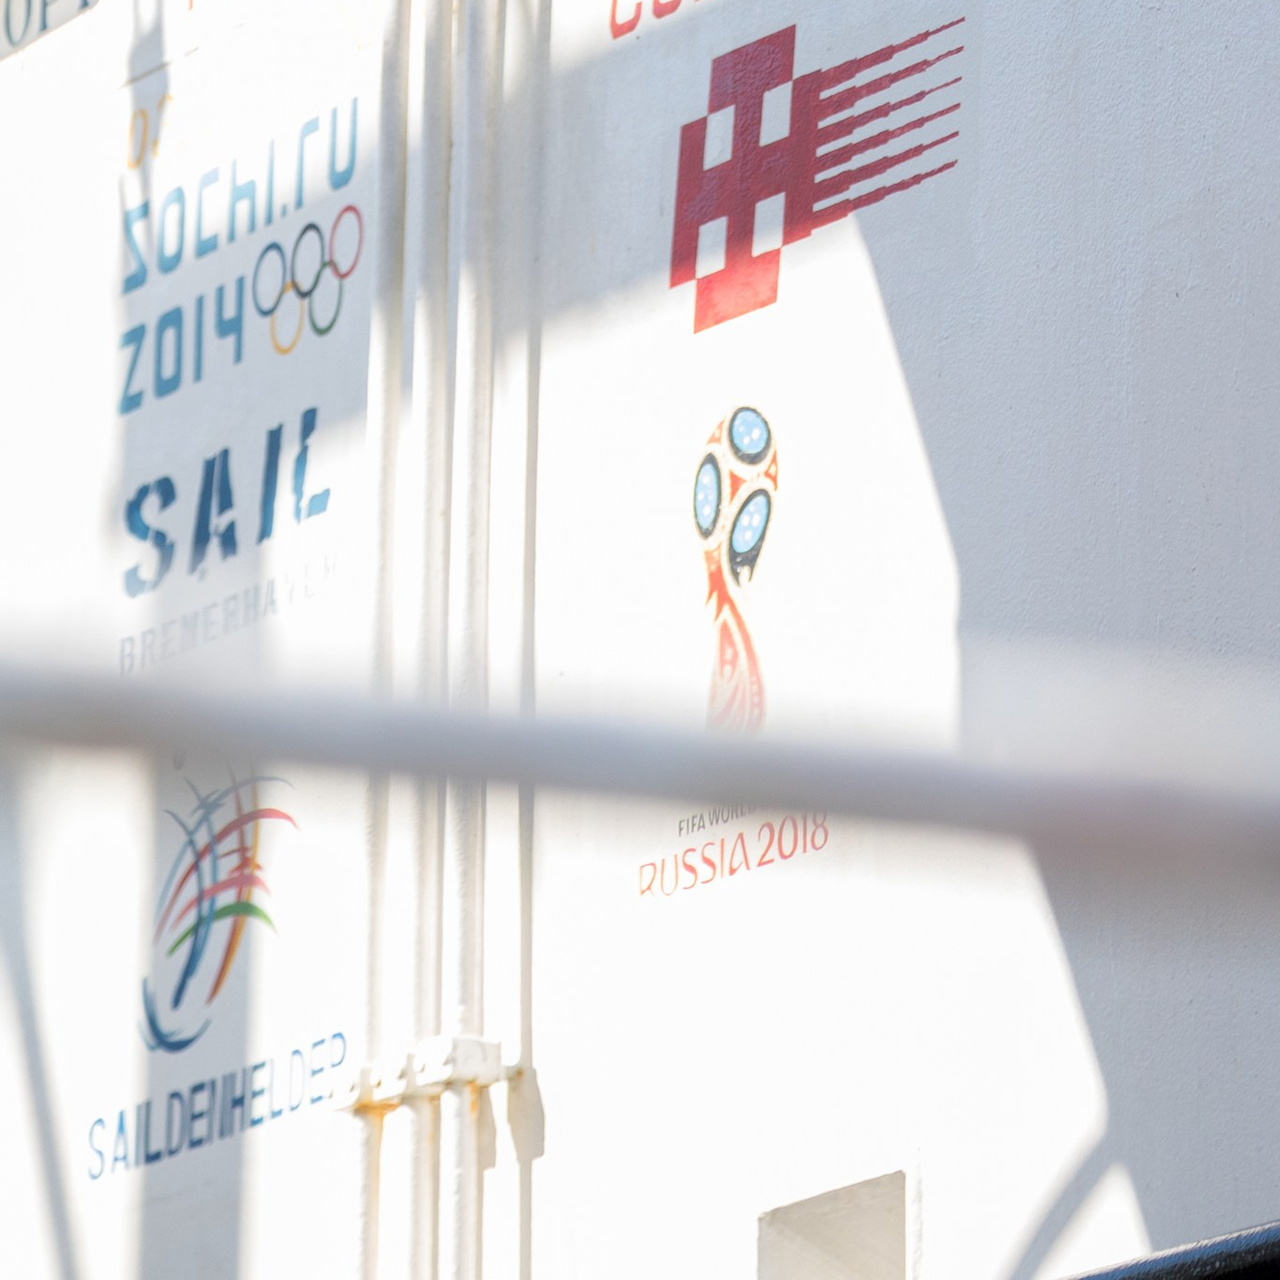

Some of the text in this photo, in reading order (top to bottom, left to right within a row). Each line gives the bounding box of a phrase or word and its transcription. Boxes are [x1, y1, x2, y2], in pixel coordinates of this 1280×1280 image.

[117, 274, 246, 416] 2014
[123, 406, 332, 599] SAIL
[638, 809, 830, 897] RUSSIA 2018
[677, 811, 707, 838] FIFA
